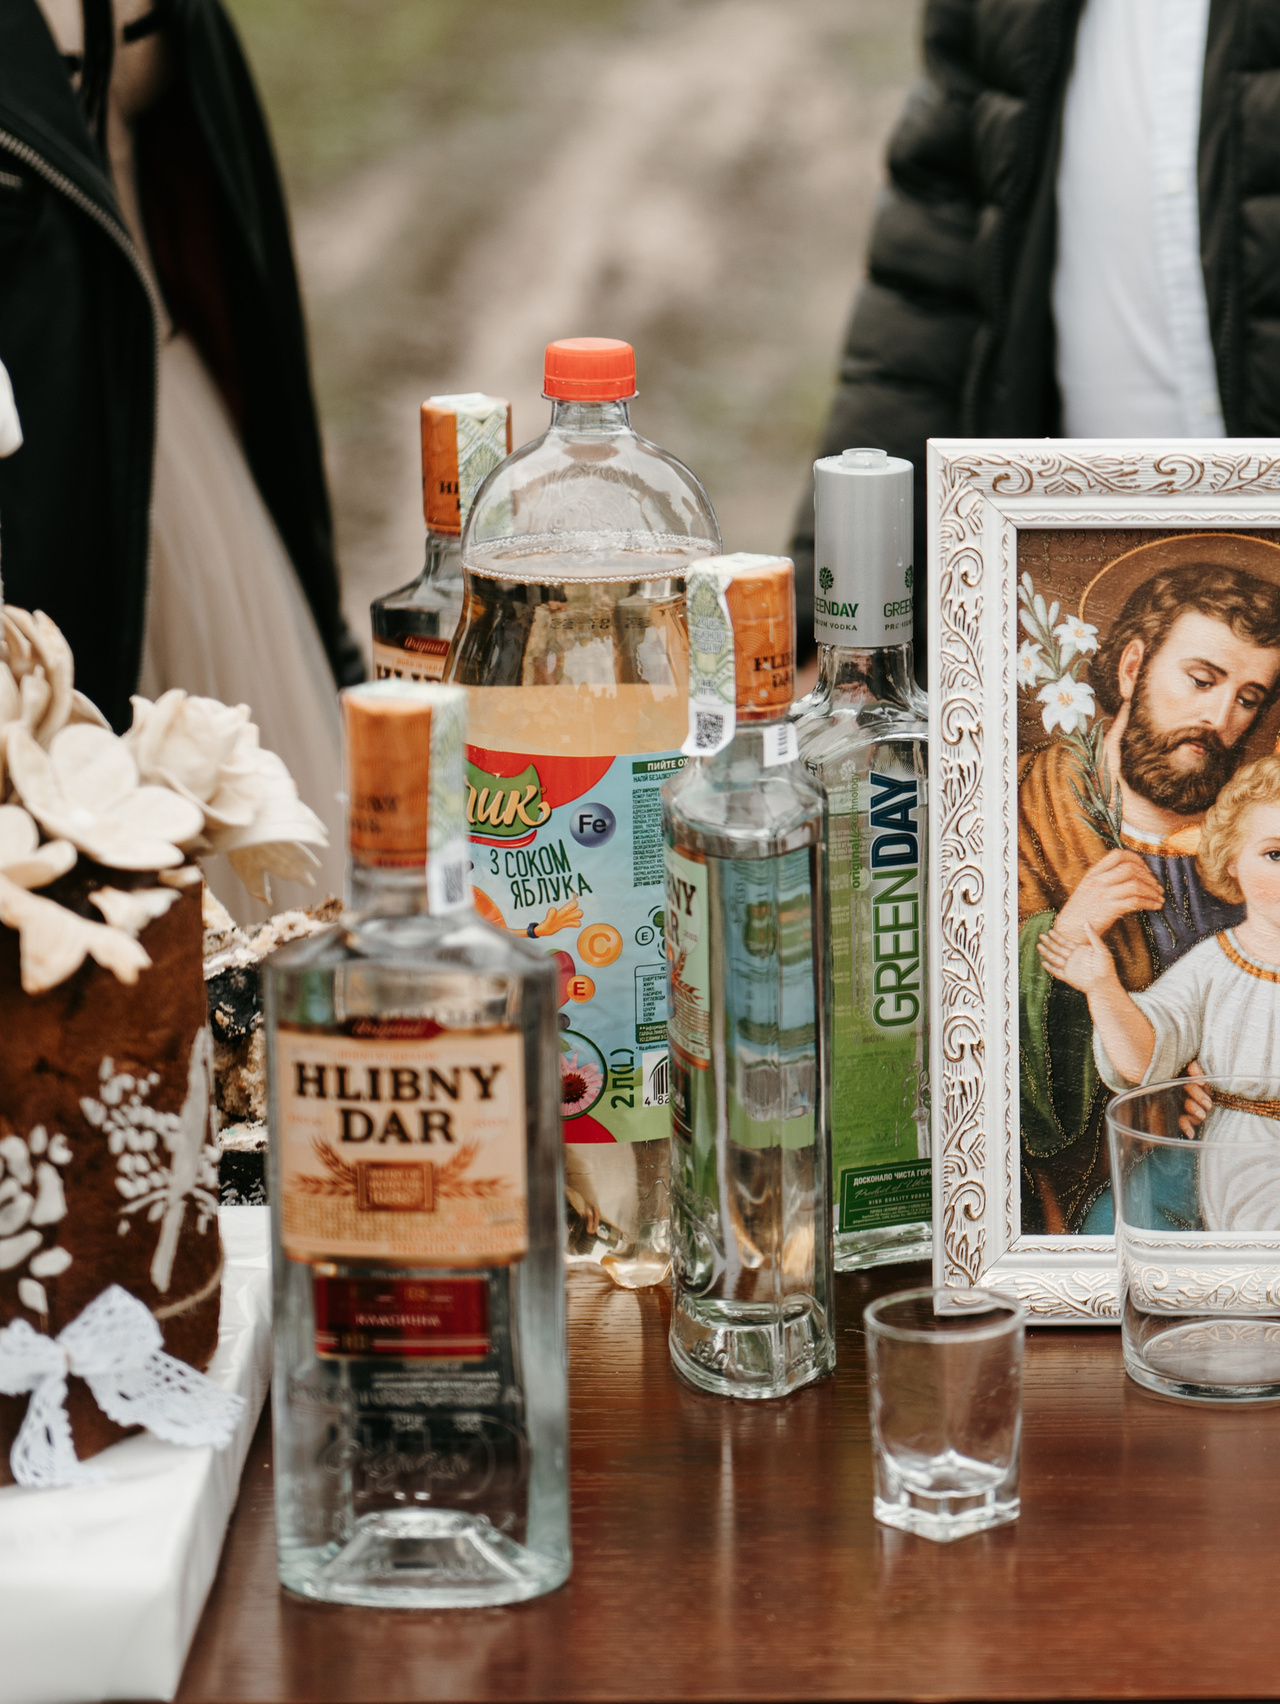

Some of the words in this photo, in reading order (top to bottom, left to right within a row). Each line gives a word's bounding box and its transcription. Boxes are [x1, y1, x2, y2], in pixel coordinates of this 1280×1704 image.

[814, 597, 859, 618] EENDAY
[830, 622, 858, 631] VODKA
[647, 760, 676, 771] ПИЙТЕ
[850, 772, 861, 826] technology
[578, 814, 607, 834] Fe
[490, 848, 500, 876] З
[504, 839, 572, 879] СОКОМ
[849, 838, 862, 889] original
[510, 872, 593, 910] ЯБЛУКА
[870, 770, 921, 1028] GREENDAY
[588, 932, 612, 958] C
[641, 931, 649, 941] E
[572, 981, 586, 996] E
[293, 1061, 503, 1101] HLIBNY
[645, 1096, 651, 1106] 4
[657, 1095, 670, 1105] 82
[339, 1108, 455, 1144] DAR
[853, 1172, 893, 1187] ДОСКОНАЛО
[894, 1170, 916, 1180] ЧИСТА
[885, 1195, 909, 1203] QUALITY
[911, 1192, 930, 1200] VODKA
